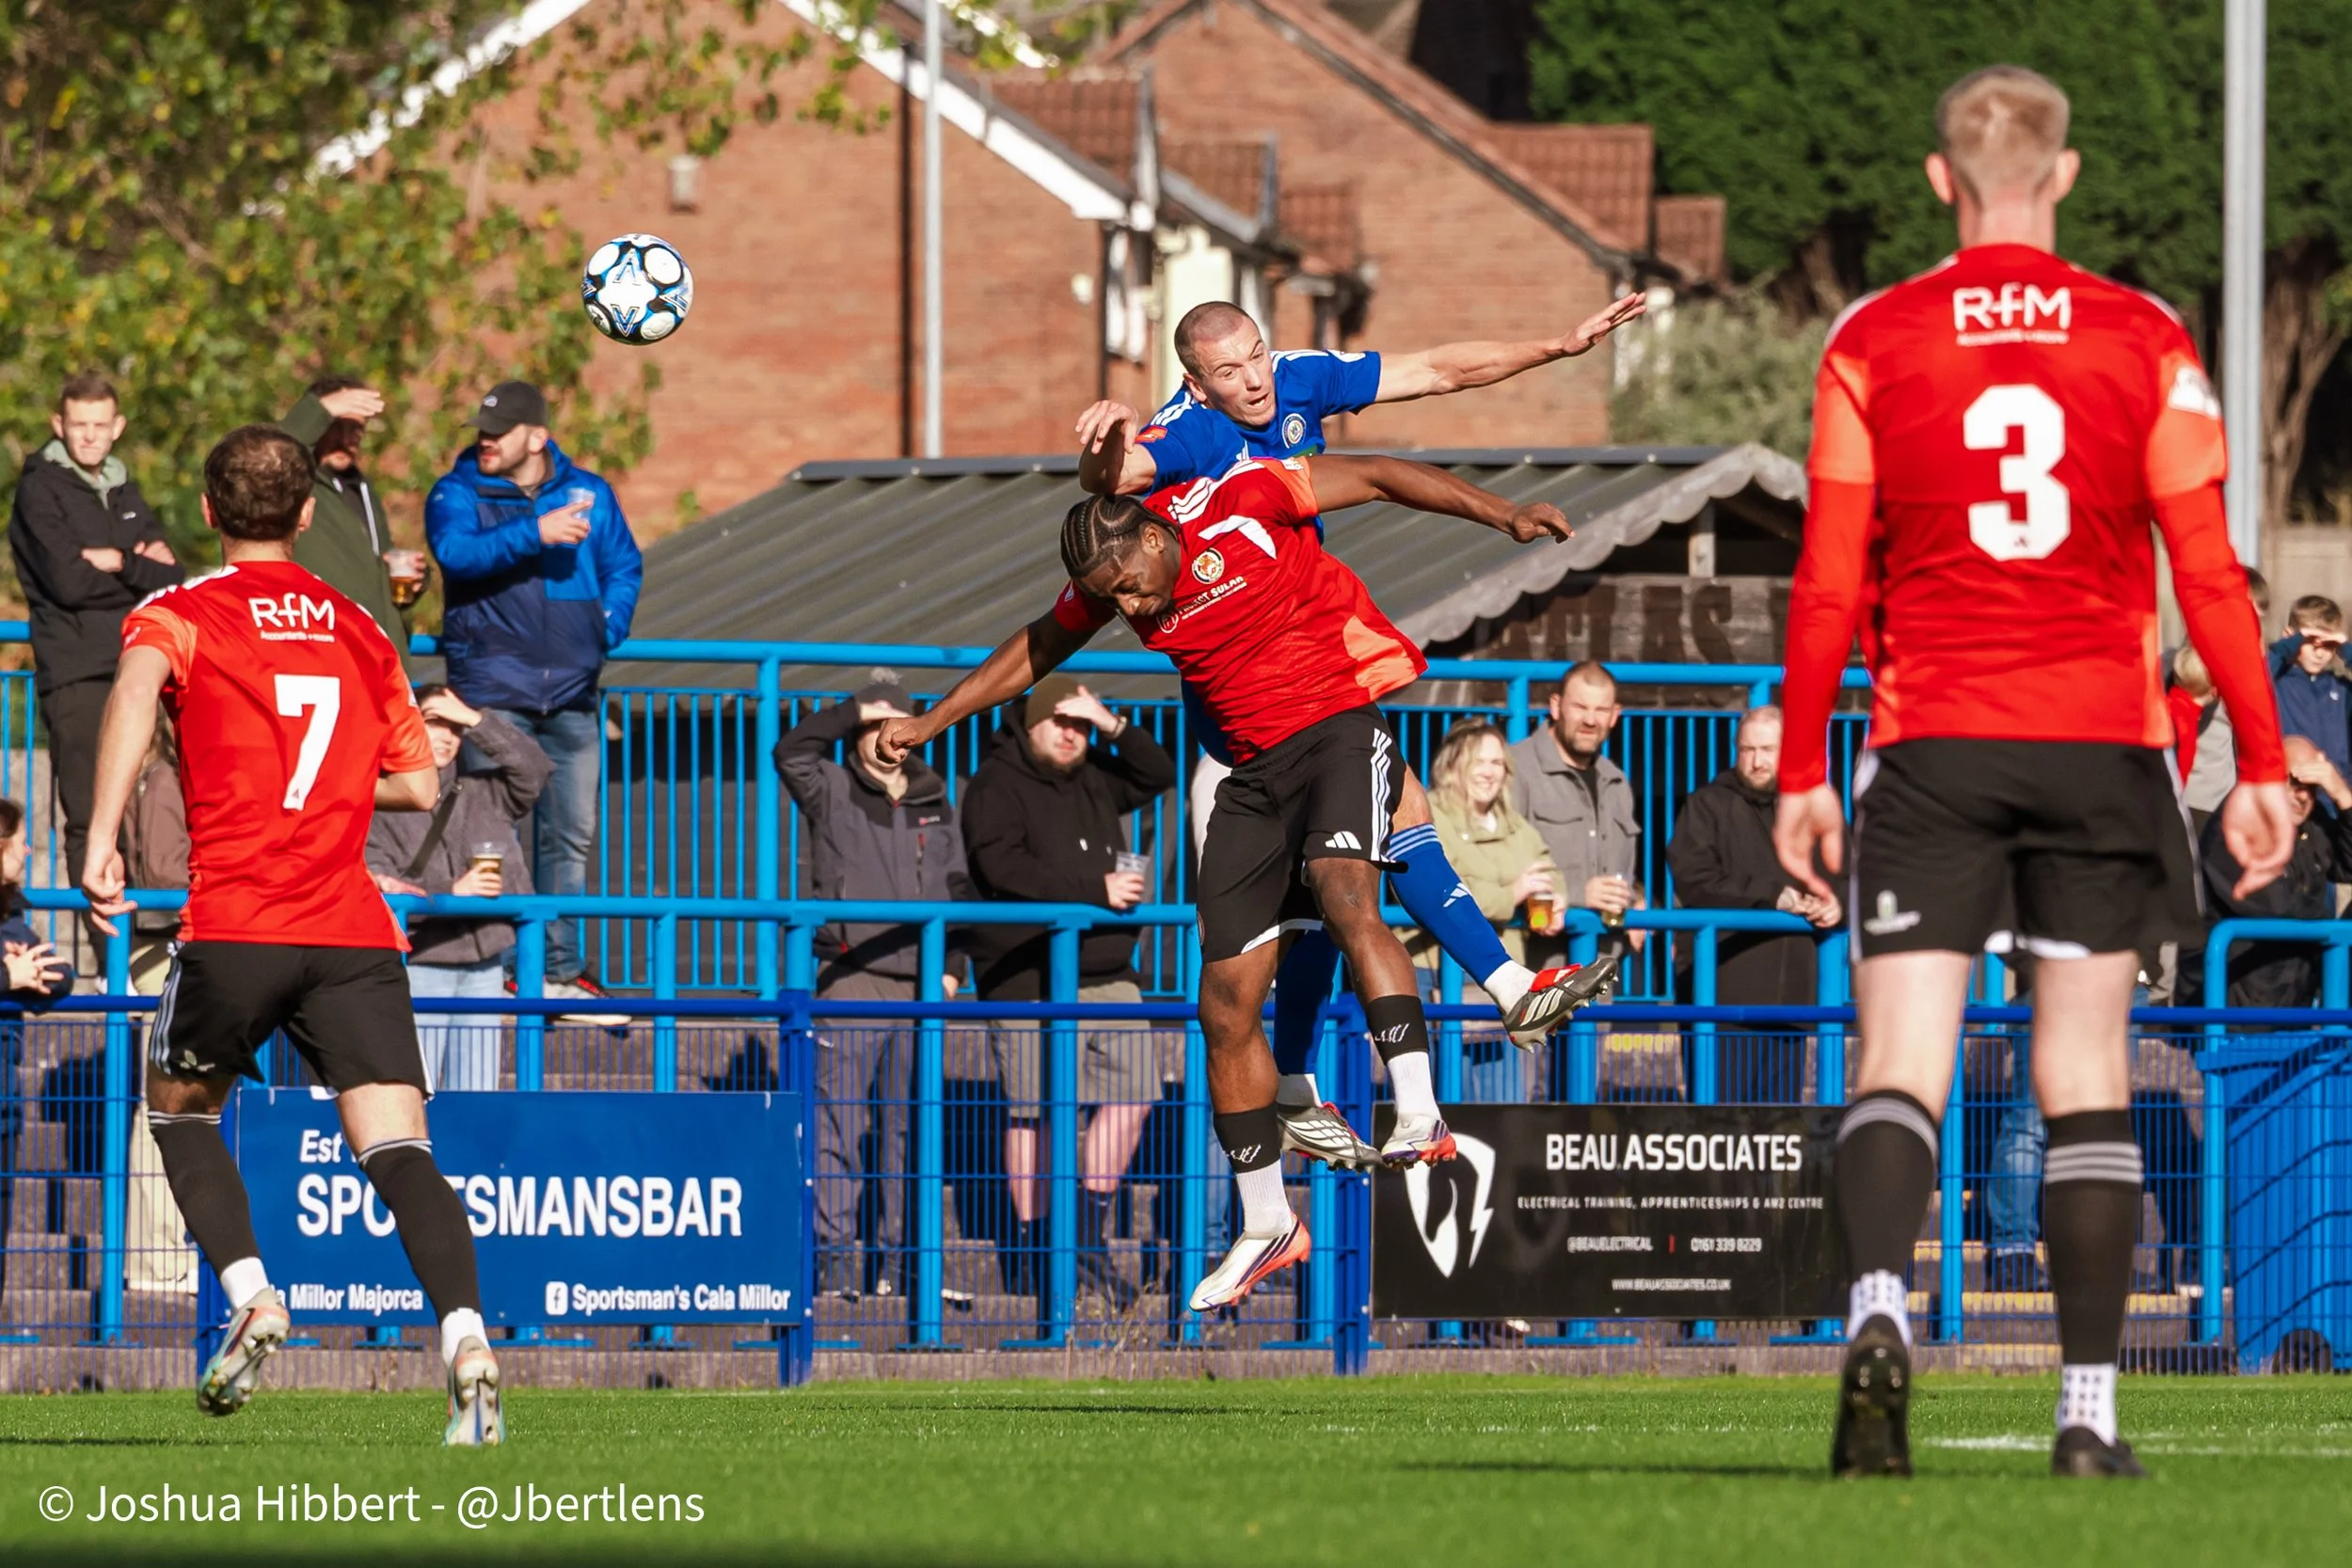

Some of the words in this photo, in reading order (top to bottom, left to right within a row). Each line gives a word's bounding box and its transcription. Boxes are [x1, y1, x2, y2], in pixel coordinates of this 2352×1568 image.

[1953, 281, 2072, 331] RfM
[1963, 384, 2072, 562] 3
[248, 593, 335, 630] RfM
[274, 673, 341, 812] 7
[299, 1130, 342, 1163] Est
[1546, 1133, 1618, 1171] BEAU
[1623, 1133, 1803, 1171] ASSOCIATES
[296, 1173, 742, 1238] SPOSMANSBAR
[1518, 1196, 1581, 1209] ELECTRICAL
[1641, 1196, 1749, 1209] APPRENTICESHIPS
[1788, 1196, 1823, 1209] CENTRE
[290, 1284, 345, 1309] Millor
[348, 1284, 423, 1316] Majorca
[572, 1283, 691, 1316] Sportsman's
[693, 1284, 736, 1310] Cala
[739, 1284, 790, 1310] Millor
